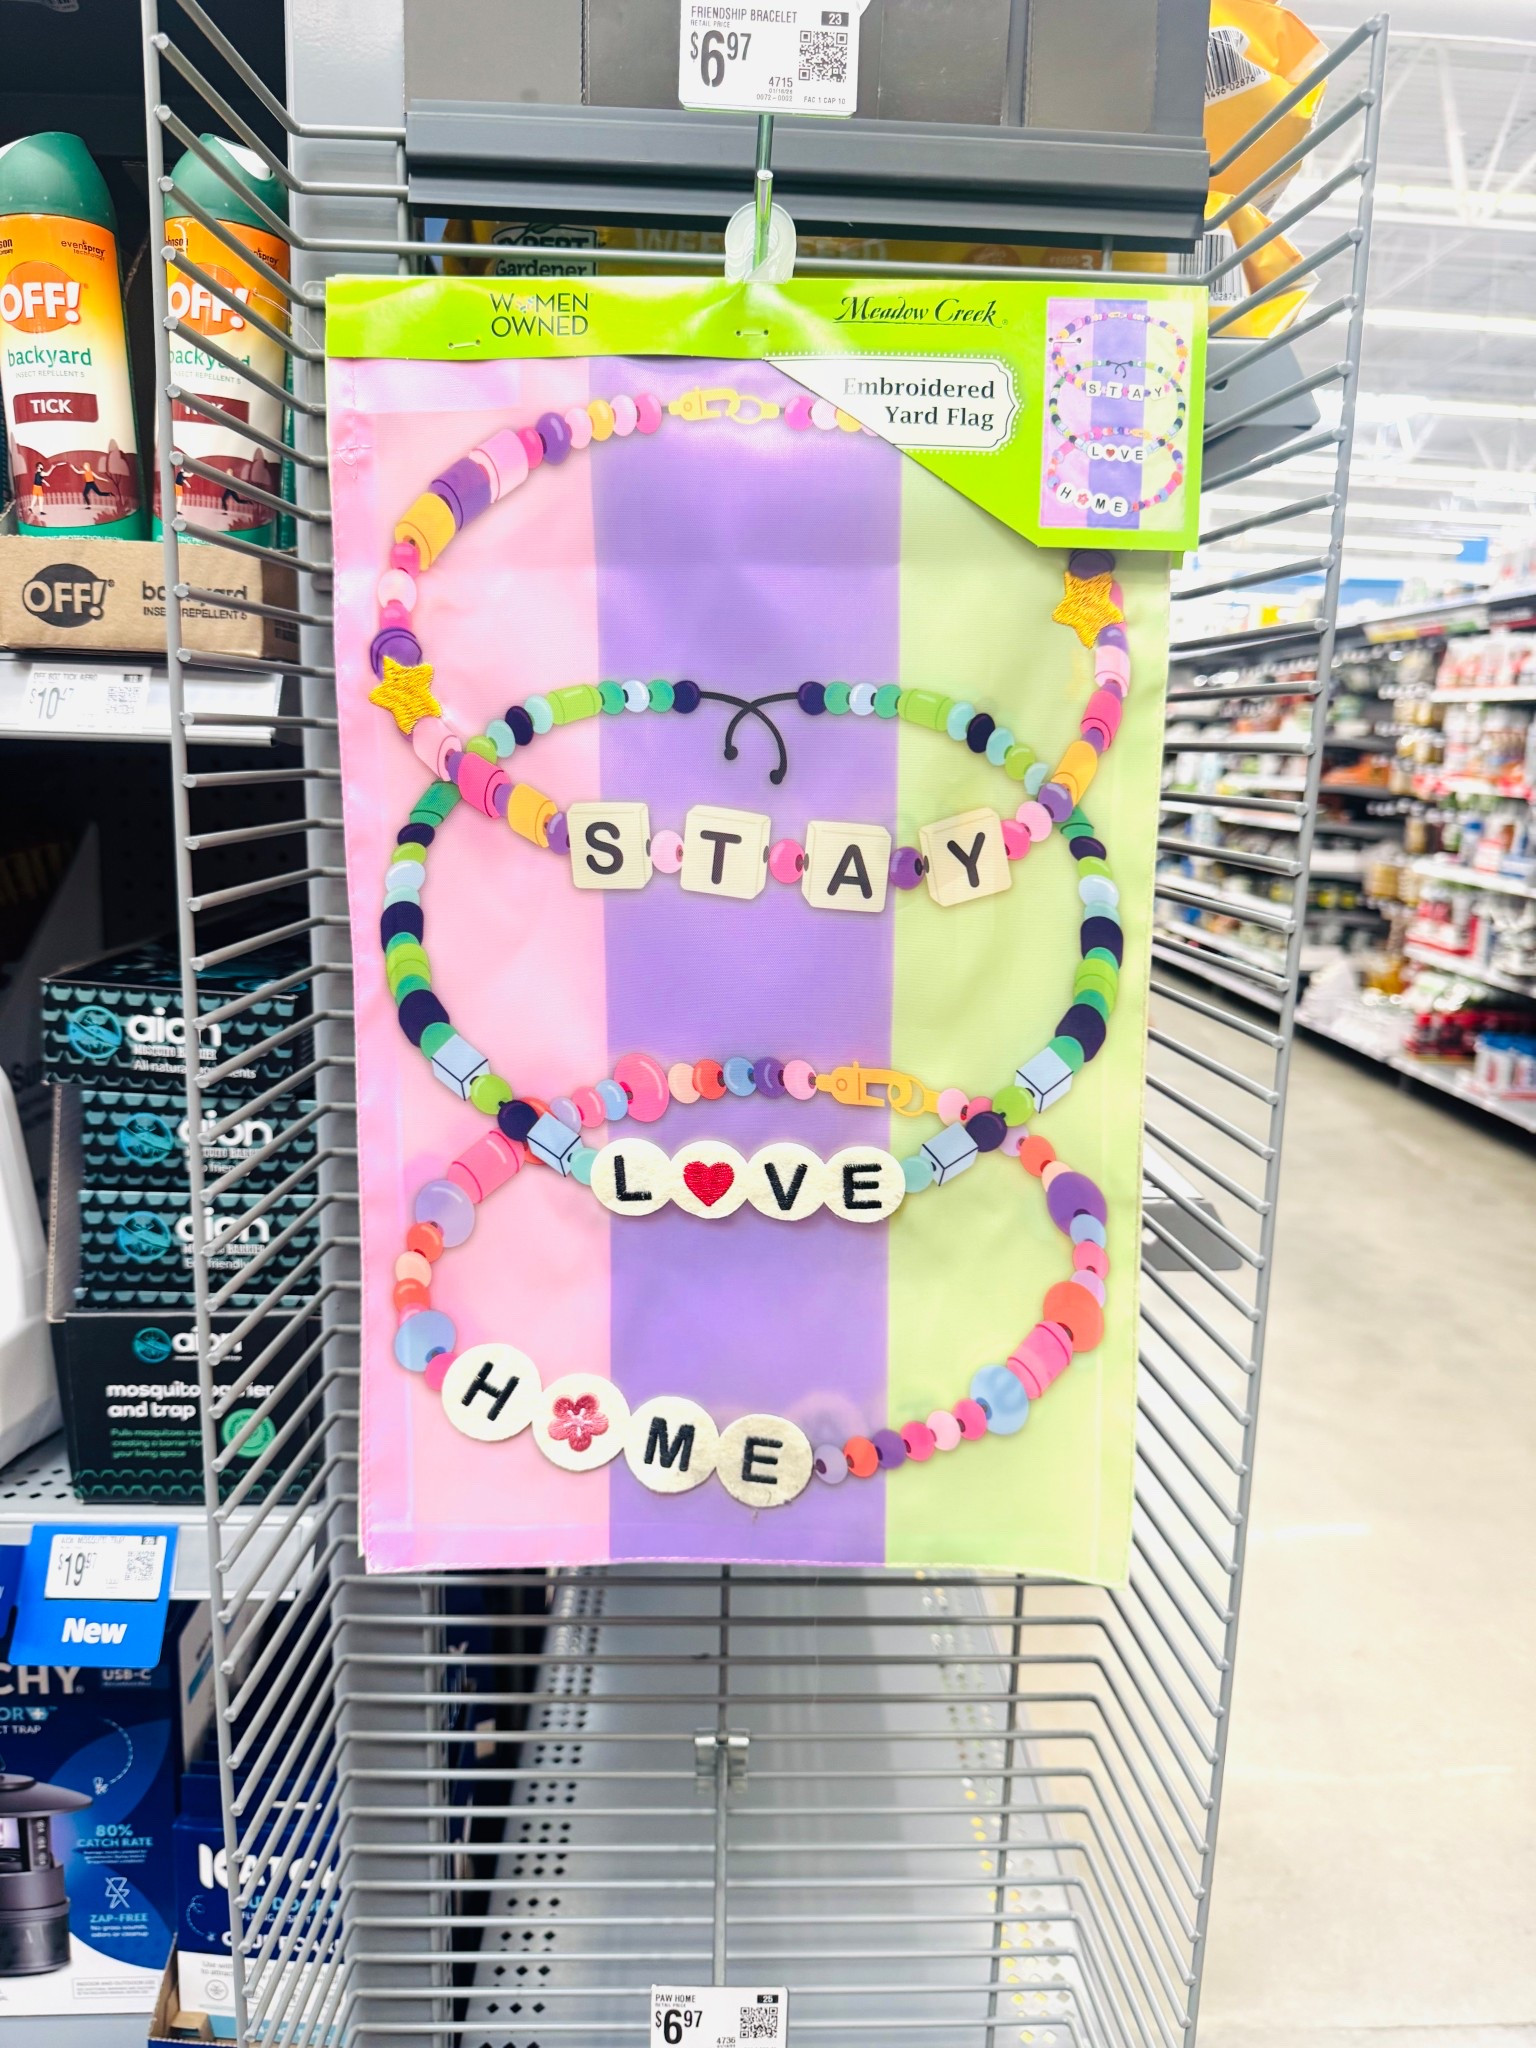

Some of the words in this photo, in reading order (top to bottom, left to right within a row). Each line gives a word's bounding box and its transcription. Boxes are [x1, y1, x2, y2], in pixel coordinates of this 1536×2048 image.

[691, 6, 747, 20] FRIENDSHIP
[750, 9, 798, 24] BRACELET
[829, 13, 842, 25] 23
[768, 76, 793, 88] 4715
[496, 259, 587, 276] Gardener
[0, 282, 80, 323] OFF!
[832, 296, 929, 321] Meadow
[934, 298, 1002, 328] Creek
[491, 315, 588, 337] OWNED
[8, 345, 92, 367] backyard
[843, 377, 995, 399] Embroidered
[1088, 384, 1164, 399] STAY
[30, 398, 73, 414] TICK
[885, 406, 938, 425] Yard
[947, 407, 995, 431] Flag
[23, 580, 107, 620] OFF!
[182, 609, 238, 620] REPELLENT
[585, 821, 985, 900] STAY
[151, 1063, 186, 1075] natura
[175, 1206, 270, 1243] aion
[106, 1380, 201, 1401] mosquito
[107, 1401, 149, 1418] and
[151, 1402, 196, 1421] trap
[61, 1618, 127, 1644] New
[102, 1669, 151, 1680] USB-C
[12, 1725, 41, 1735] TRAP
[96, 1824, 133, 1838] 80%
[76, 1838, 119, 1848] CATCH
[122, 1836, 153, 1847] RATE
[90, 1912, 148, 1924] ZAP-FREE
[655, 1994, 673, 2002] PAW
[675, 1994, 696, 2003] HOME
[717, 2037, 736, 2045] 4736
